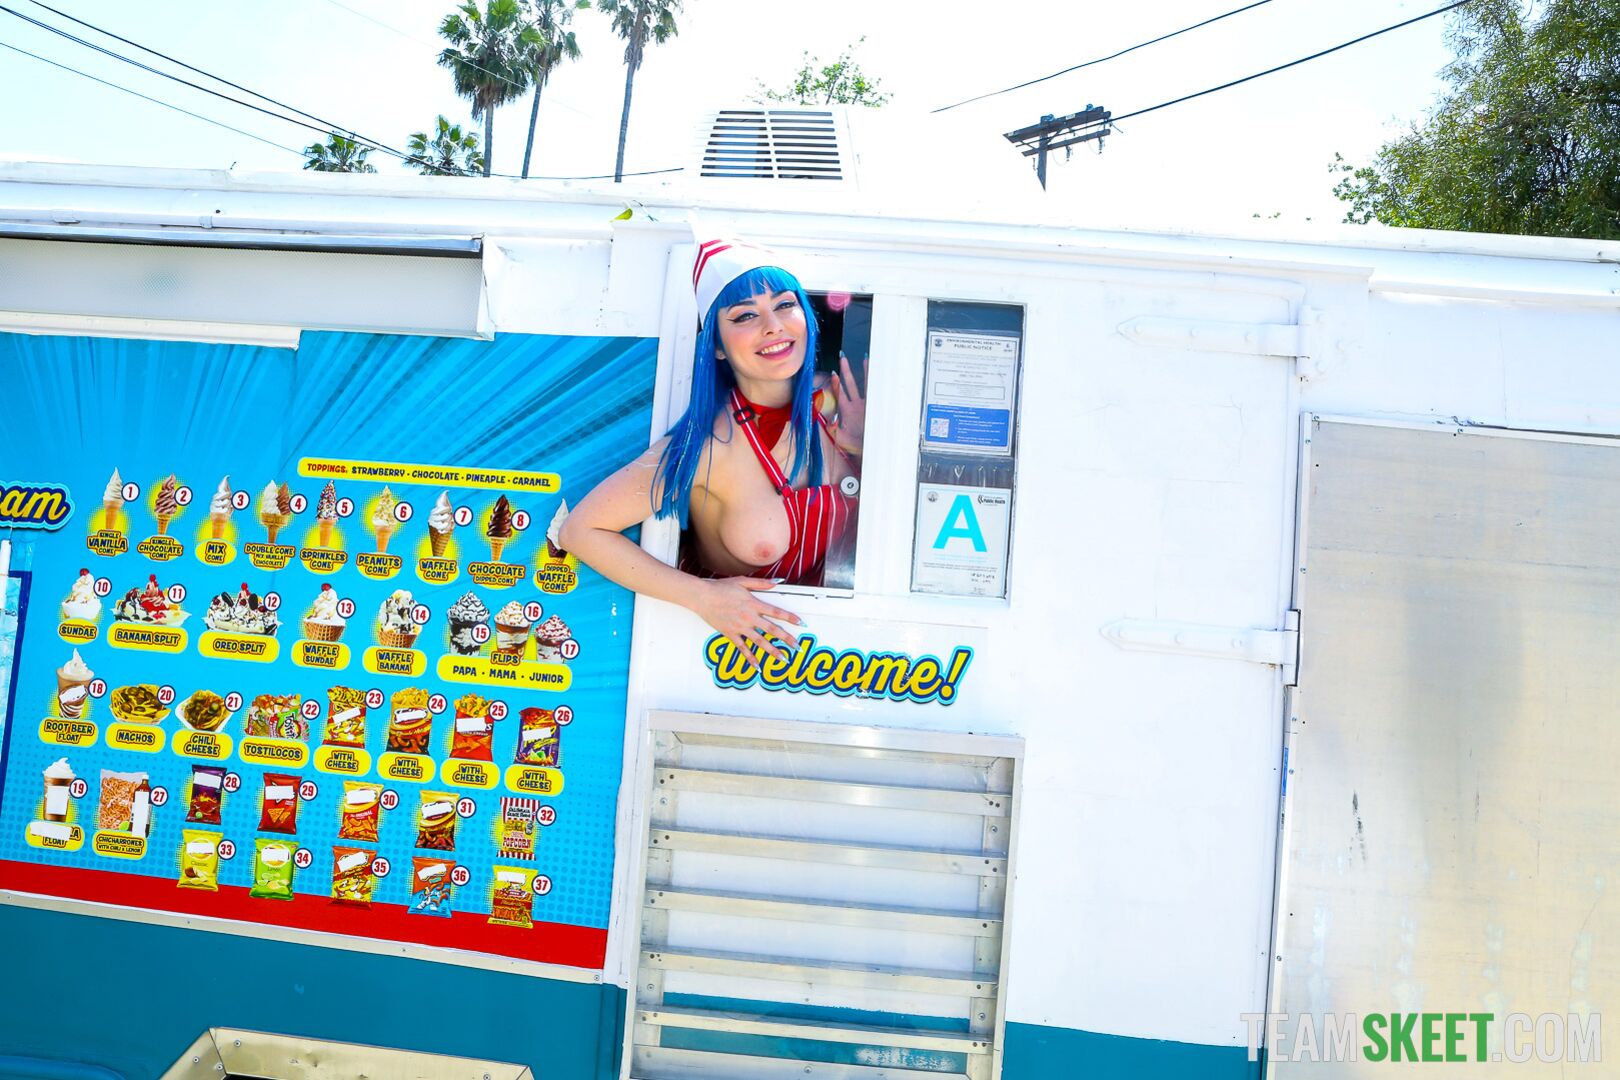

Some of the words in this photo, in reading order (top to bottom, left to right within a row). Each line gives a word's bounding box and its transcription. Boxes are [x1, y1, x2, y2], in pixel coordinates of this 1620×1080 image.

[351, 466, 405, 477] STRAWBERRY
[412, 470, 459, 480] CHOCOLATE
[466, 473, 506, 484] PINEAPLE
[512, 476, 551, 487] CARAMEL
[128, 487, 133, 497] 1
[180, 491, 187, 502] 2
[0, 489, 67, 520] am
[237, 494, 244, 506] 3
[294, 498, 302, 510] 4
[341, 502, 348, 513] 5
[399, 506, 406, 518] 6
[460, 510, 467, 522] 7
[517, 514, 524, 526] 8
[932, 494, 988, 553] A
[88, 538, 125, 549] VANILLA
[139, 544, 181, 554] CHOCOLATE
[208, 544, 224, 554] MIX
[246, 545, 273, 554] DOUBLE
[275, 547, 293, 555] CONE
[302, 551, 345, 561] SPRINKLES
[359, 555, 399, 567] PEANUTS
[312, 560, 331, 569] CONE
[367, 566, 387, 574] CONE
[421, 561, 455, 571] WAFFLE
[425, 570, 447, 578] CONE
[469, 565, 523, 576] CHOCOLATE
[539, 572, 573, 583] WAFFLE
[98, 582, 108, 593] 10
[544, 582, 566, 591] CONE
[172, 588, 182, 599] 11
[267, 596, 277, 608] 12
[341, 602, 352, 614] 13
[528, 606, 539, 617] 16
[415, 610, 426, 621] 14
[61, 626, 95, 637] SUNDAE
[476, 628, 486, 639] 15
[117, 631, 152, 642] BANANA
[153, 633, 179, 645] SPLIT
[214, 640, 238, 650] OREO
[239, 642, 264, 653] SPLIT
[305, 645, 337, 656] WAFFLE
[564, 643, 576, 655] 17
[305, 655, 334, 665] SUNDAE
[378, 652, 412, 663] WAFFLE
[493, 653, 519, 664] FLIPS
[379, 662, 410, 672] BANANA
[706, 633, 969, 699] Welcome!
[452, 665, 477, 677] PAPA
[489, 668, 517, 680] MAMA
[529, 672, 564, 684] JUNIOR
[92, 684, 103, 695] 18
[159, 690, 172, 701] 20
[369, 693, 381, 704] 23
[227, 696, 238, 707] 21
[431, 698, 443, 709] 24
[305, 704, 317, 715] 22
[491, 705, 504, 716] 25
[557, 710, 569, 722] 26
[46, 721, 69, 732] ROOT
[71, 724, 93, 734] BEER
[58, 733, 79, 742] FLOAT
[118, 732, 153, 743] NACHOS
[192, 735, 214, 745] CHILI
[185, 744, 219, 755] CHEESE
[245, 745, 301, 759] TOSTILOCOS
[333, 752, 352, 761] WITH
[327, 760, 357, 770] CHEESE
[397, 759, 416, 767] WITH
[391, 767, 421, 777] CHEESE
[460, 766, 480, 774] WITH
[454, 773, 485, 783] CHEESE
[525, 772, 545, 781] WITH
[224, 777, 236, 788] 28
[518, 780, 549, 790] CHEESE
[74, 784, 84, 795] 19
[302, 785, 314, 796] 29
[153, 792, 164, 802] 27
[383, 795, 395, 806] 30
[461, 802, 471, 813] 31
[541, 809, 553, 821] 32
[44, 836, 65, 846] FLOAT
[98, 836, 142, 847] CHICHARRONES
[502, 836, 532, 849] POPCORN
[221, 845, 232, 856] 33
[297, 853, 308, 864] 34
[374, 862, 386, 873] 35
[454, 870, 465, 882] 36
[535, 880, 548, 891] 37
